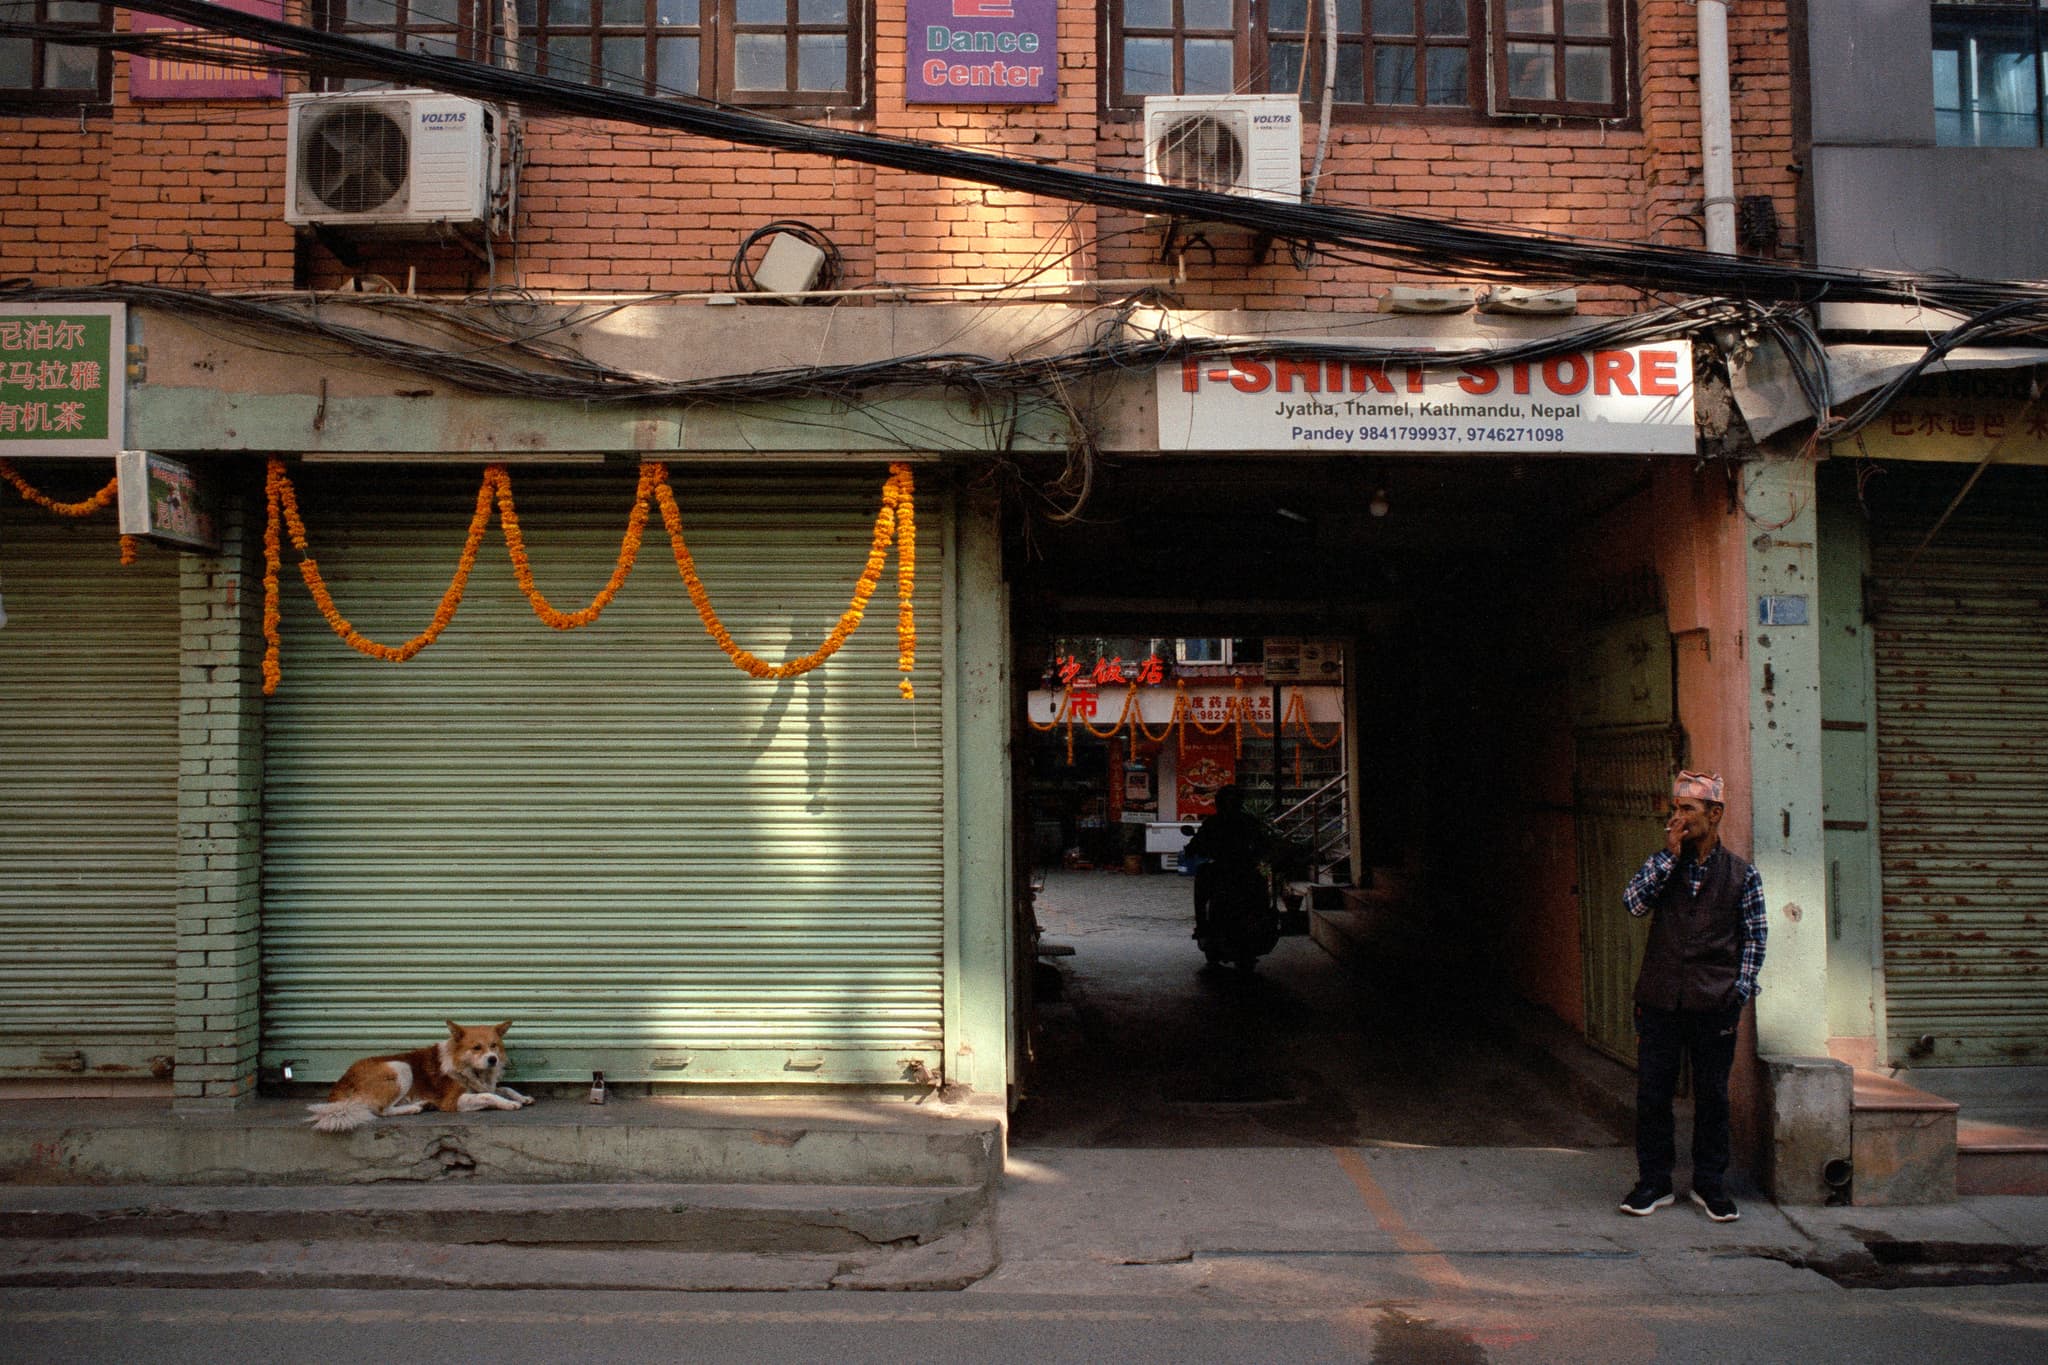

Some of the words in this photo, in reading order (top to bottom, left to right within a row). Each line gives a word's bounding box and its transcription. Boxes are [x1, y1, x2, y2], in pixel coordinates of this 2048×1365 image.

[926, 25, 1039, 53] Dance
[922, 59, 1044, 87] Center
[421, 113, 466, 123] VOLTAS
[1253, 115, 1292, 123] VOLTAS
[0, 320, 85, 350] 尼泊尔
[0, 361, 101, 390] 马拉雅
[1180, 350, 1436, 393] T-SHIRT
[1457, 350, 1679, 396] STORE
[0, 402, 85, 432] 有机茶
[1275, 401, 1338, 418] Jyatha,
[1345, 402, 1414, 418] Thamel,
[1420, 402, 1525, 419] Kathmandu,
[1531, 404, 1580, 420] Nepal
[1292, 427, 1353, 442] Pandey
[1359, 427, 1462, 442] 9841799937,
[1467, 427, 1564, 442] 9746271098
